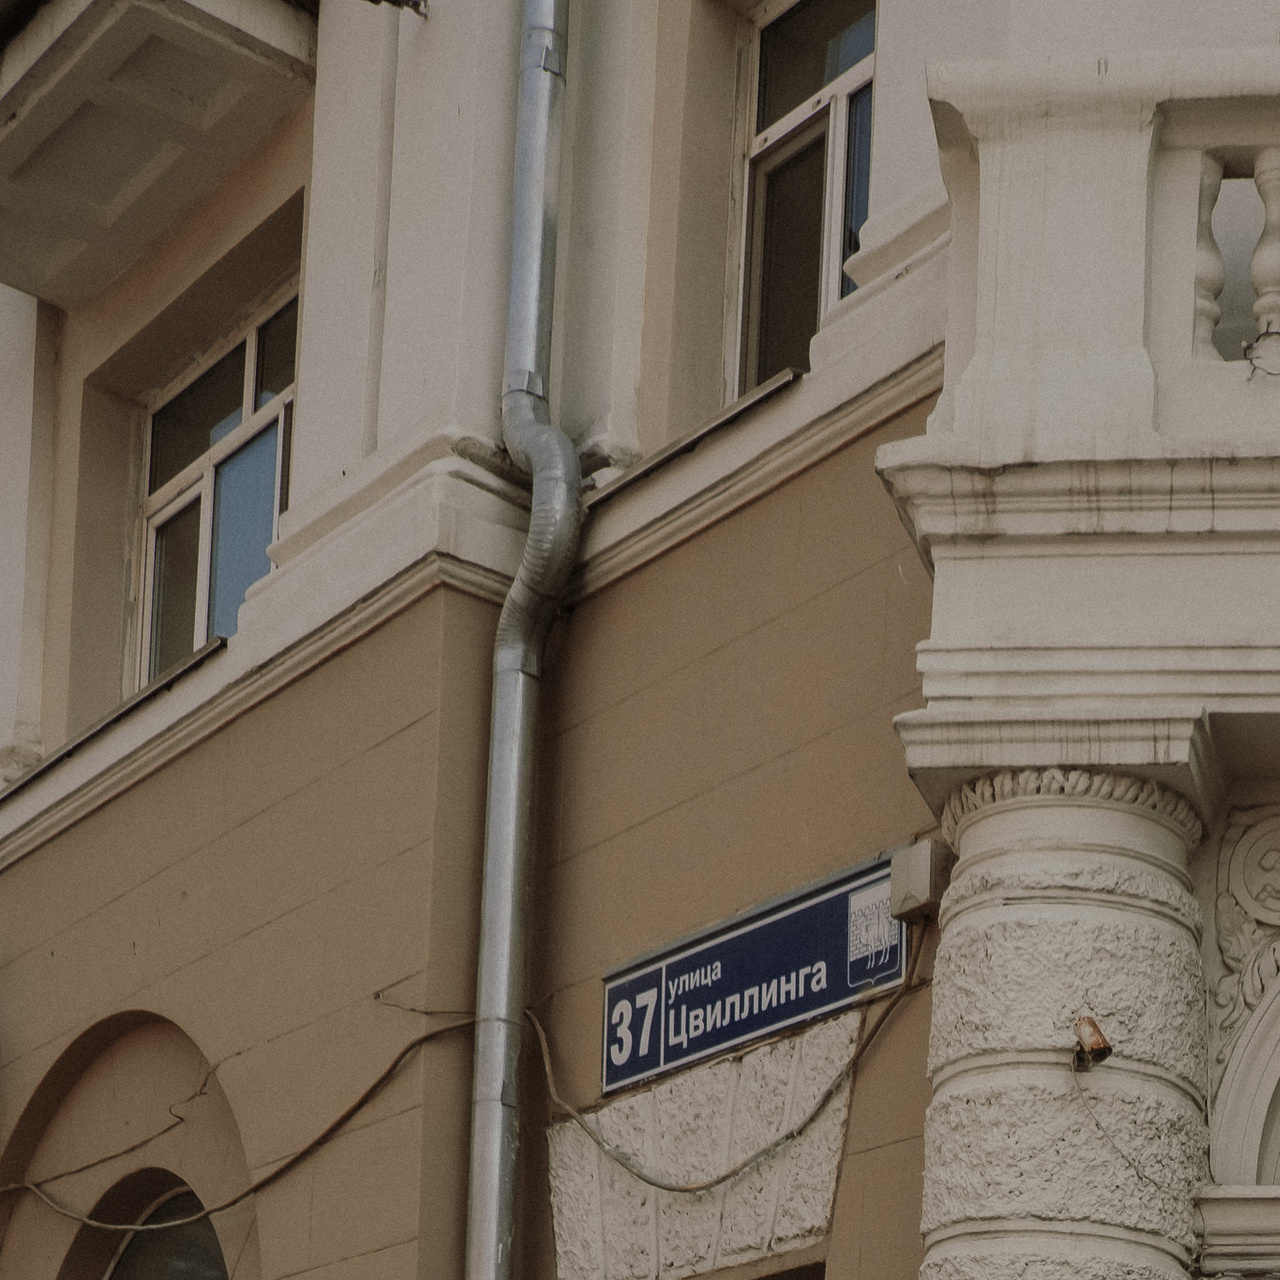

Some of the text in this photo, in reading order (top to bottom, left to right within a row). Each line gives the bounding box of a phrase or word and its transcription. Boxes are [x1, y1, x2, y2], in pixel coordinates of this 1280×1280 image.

[668, 961, 721, 1004] улица
[668, 960, 828, 1048] Цвиллинга
[610, 988, 658, 1066] 37
